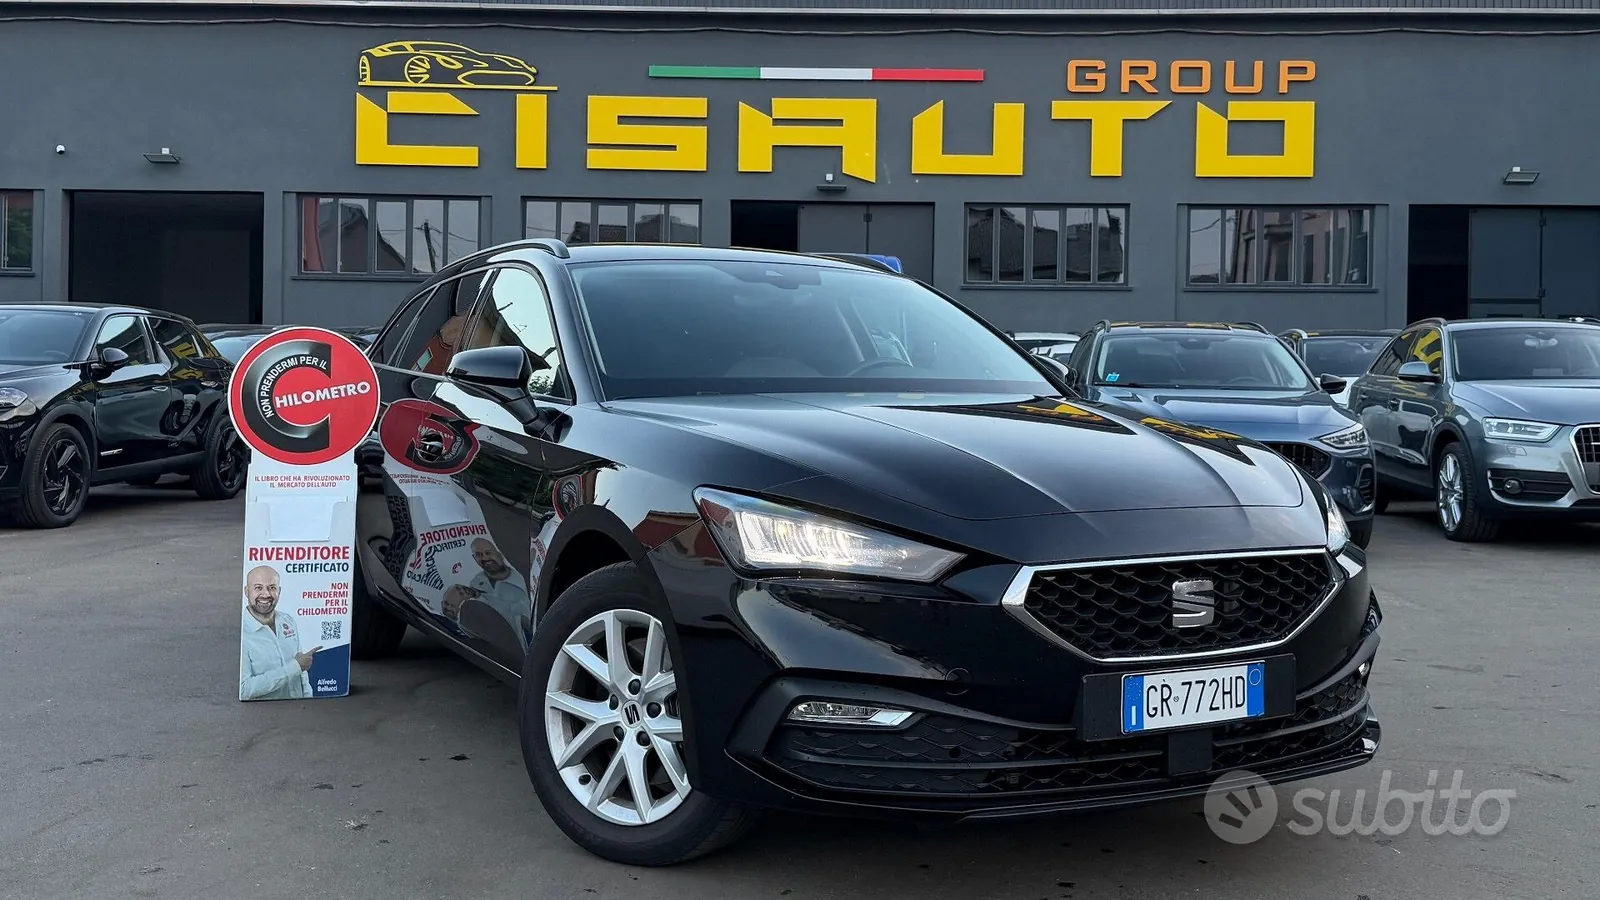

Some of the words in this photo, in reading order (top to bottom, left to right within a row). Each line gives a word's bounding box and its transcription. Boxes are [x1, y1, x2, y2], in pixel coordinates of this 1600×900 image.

[1067, 59, 1316, 94] GROUP
[355, 91, 1315, 183] CISAUTO
[300, 356, 319, 366] PER
[319, 360, 327, 370] IL
[260, 357, 298, 397] PRENDERMI
[260, 399, 274, 418] NON
[248, 546, 350, 561] RIVENDITORE
[285, 562, 349, 573] CERTIFICATO
[331, 582, 349, 590] NON
[302, 590, 348, 599] PRENDERMI
[325, 599, 340, 607] PER
[341, 599, 348, 607] IL
[297, 607, 348, 616] CHILOMETRO
[317, 678, 337, 686] Alfredo
